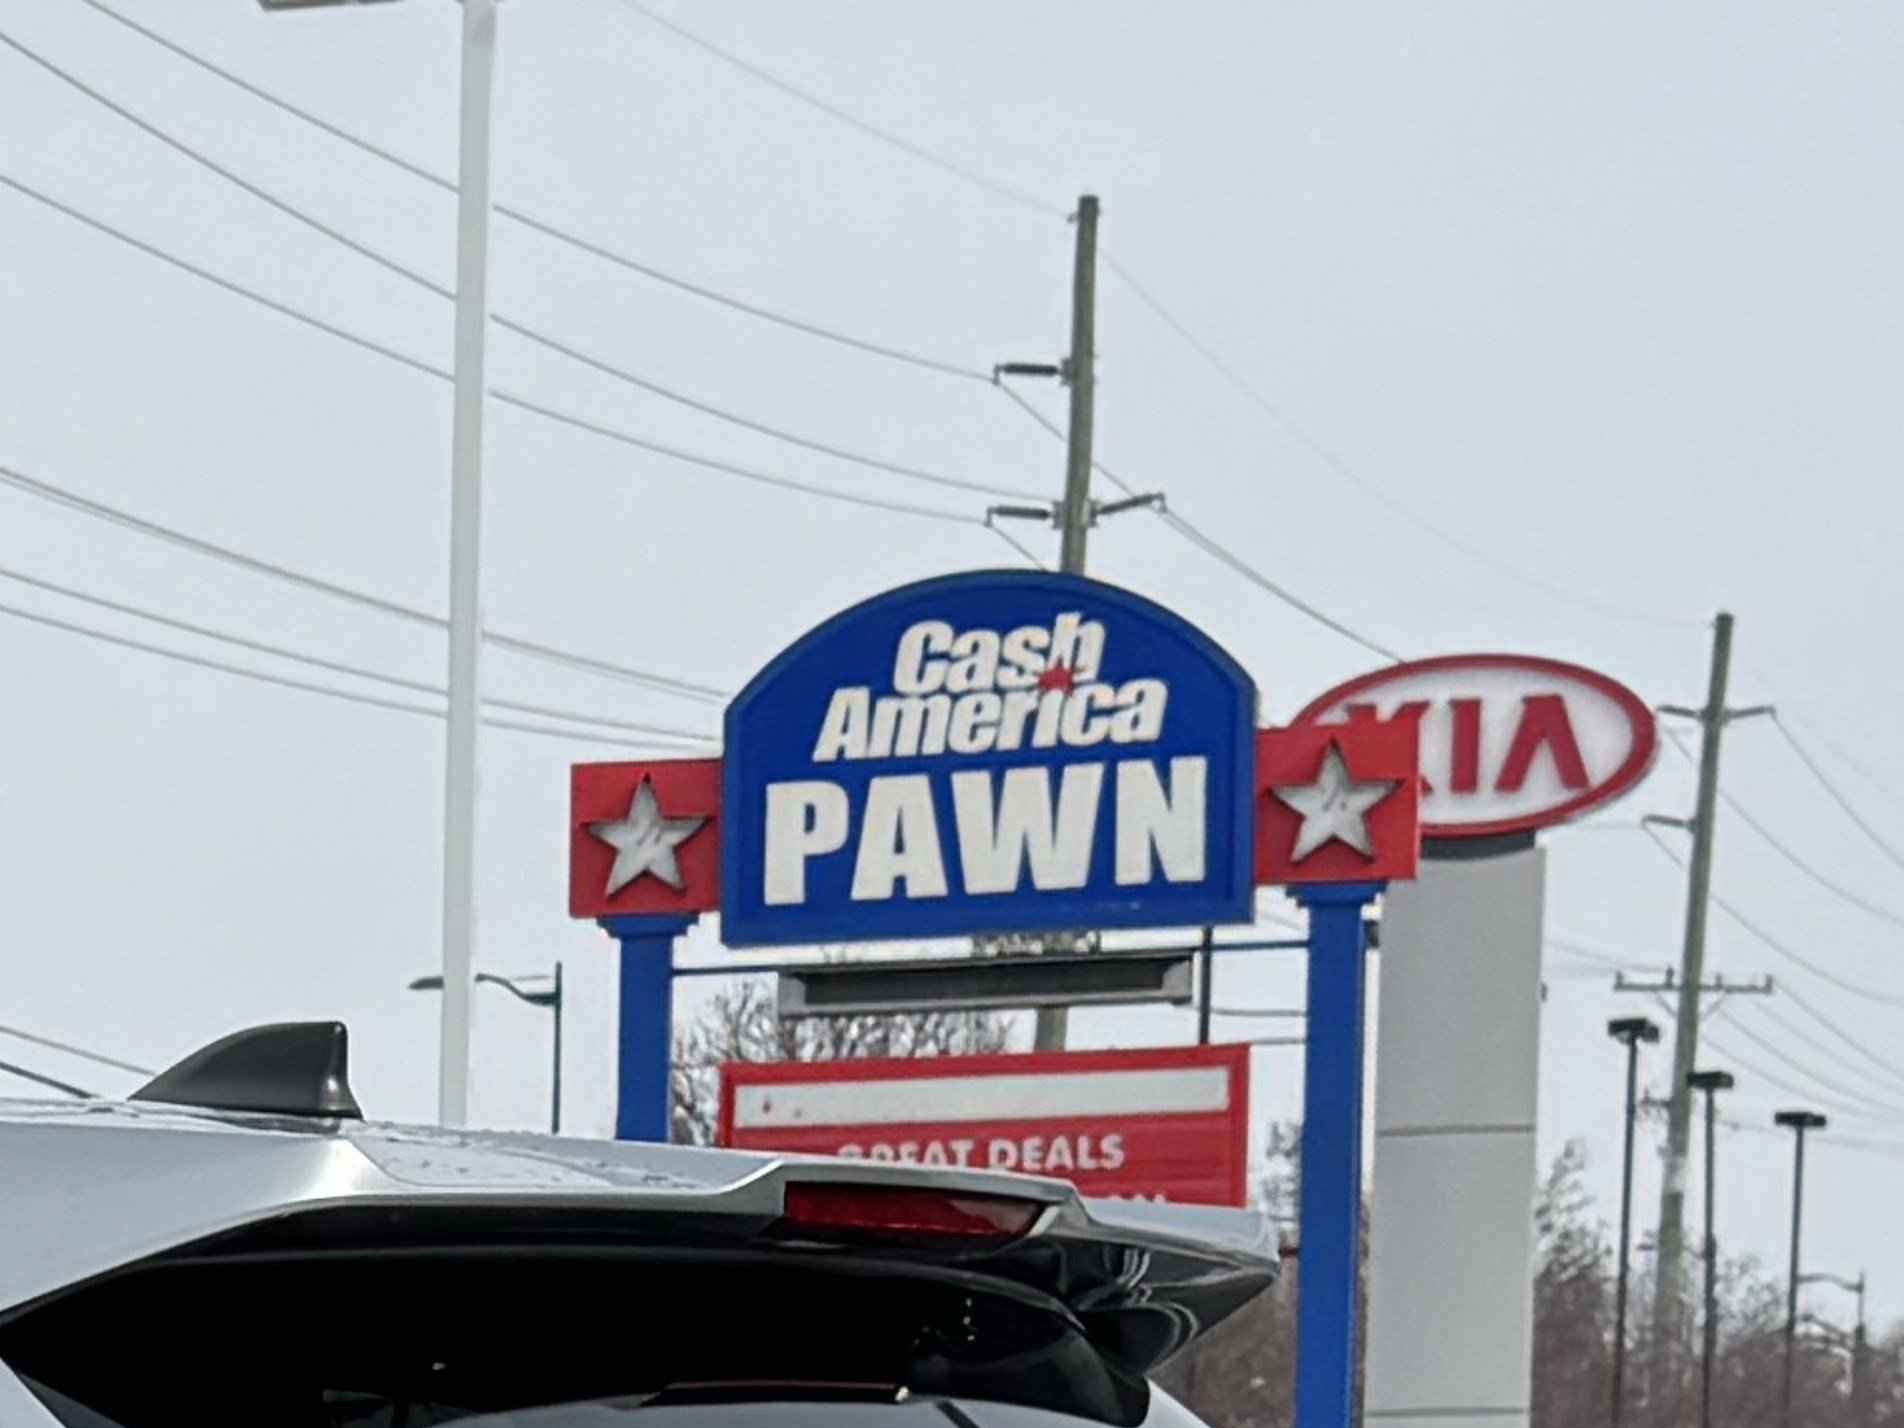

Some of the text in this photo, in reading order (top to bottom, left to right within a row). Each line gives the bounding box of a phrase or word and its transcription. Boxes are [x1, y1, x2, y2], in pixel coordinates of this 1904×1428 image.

[893, 611, 1106, 695] Cash
[813, 677, 1168, 762] America
[1346, 693, 1590, 794] IA
[763, 756, 1209, 906] PAWN
[988, 1132, 1125, 1170] DEALS
